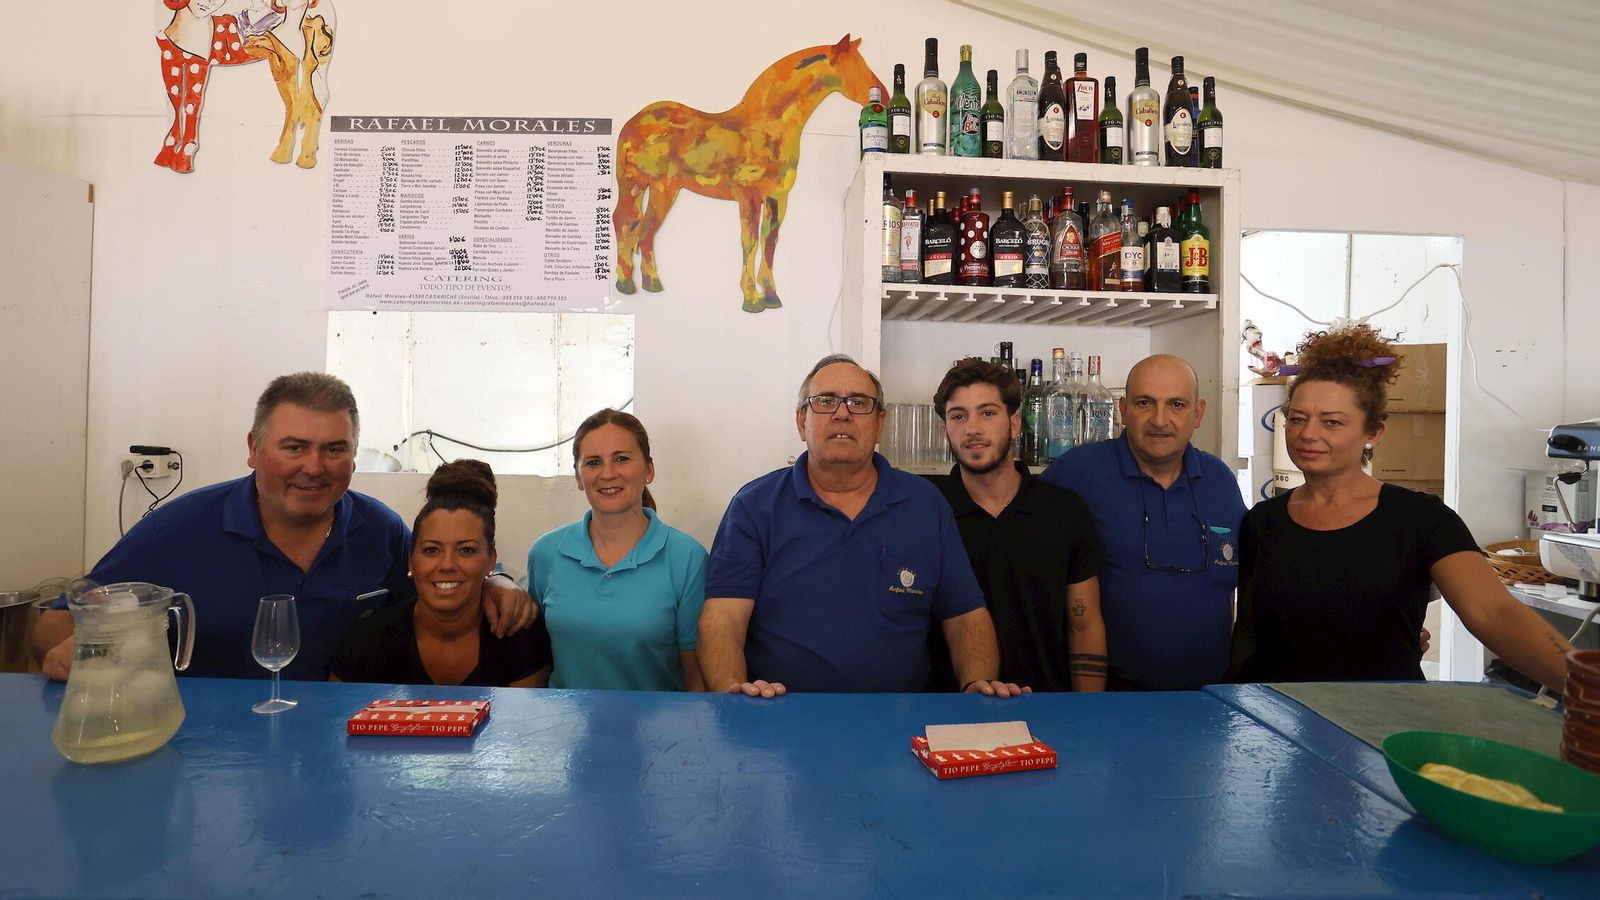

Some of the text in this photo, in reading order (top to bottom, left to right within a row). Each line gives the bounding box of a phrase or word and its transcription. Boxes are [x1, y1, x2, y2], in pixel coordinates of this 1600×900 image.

[349, 118, 596, 133] RAFAEL MORALES
[924, 237, 952, 245] BARCELÓ
[1092, 409, 1111, 418] RIVES
[960, 764, 980, 772] PEPE
[1036, 756, 1055, 765] PEPE
